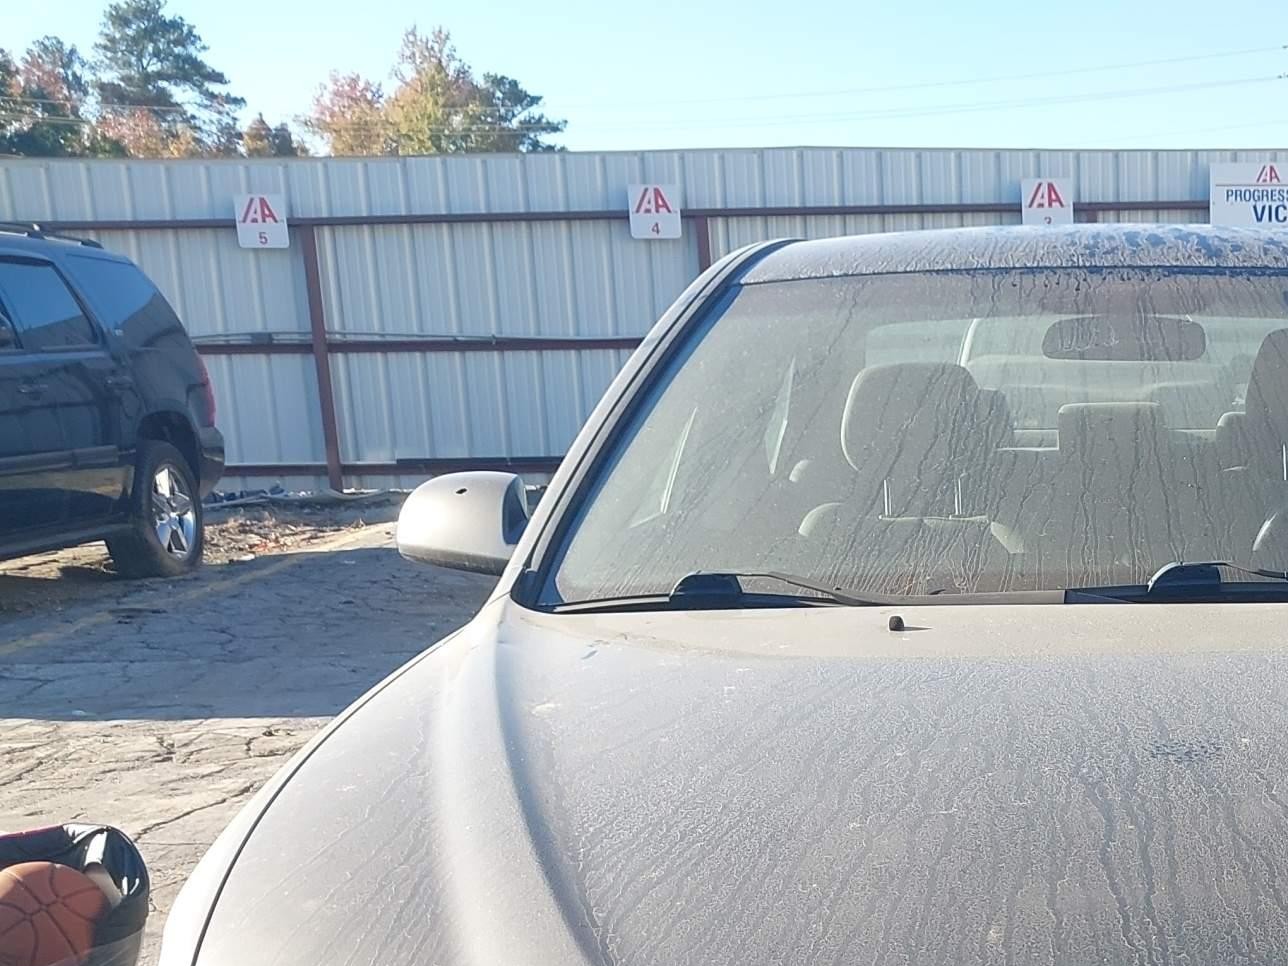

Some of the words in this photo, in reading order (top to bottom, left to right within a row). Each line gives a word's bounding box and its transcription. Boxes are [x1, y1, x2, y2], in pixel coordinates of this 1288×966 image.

[1252, 204, 1288, 223] VIC
[651, 222, 661, 235] 4
[258, 231, 268, 245] 5
